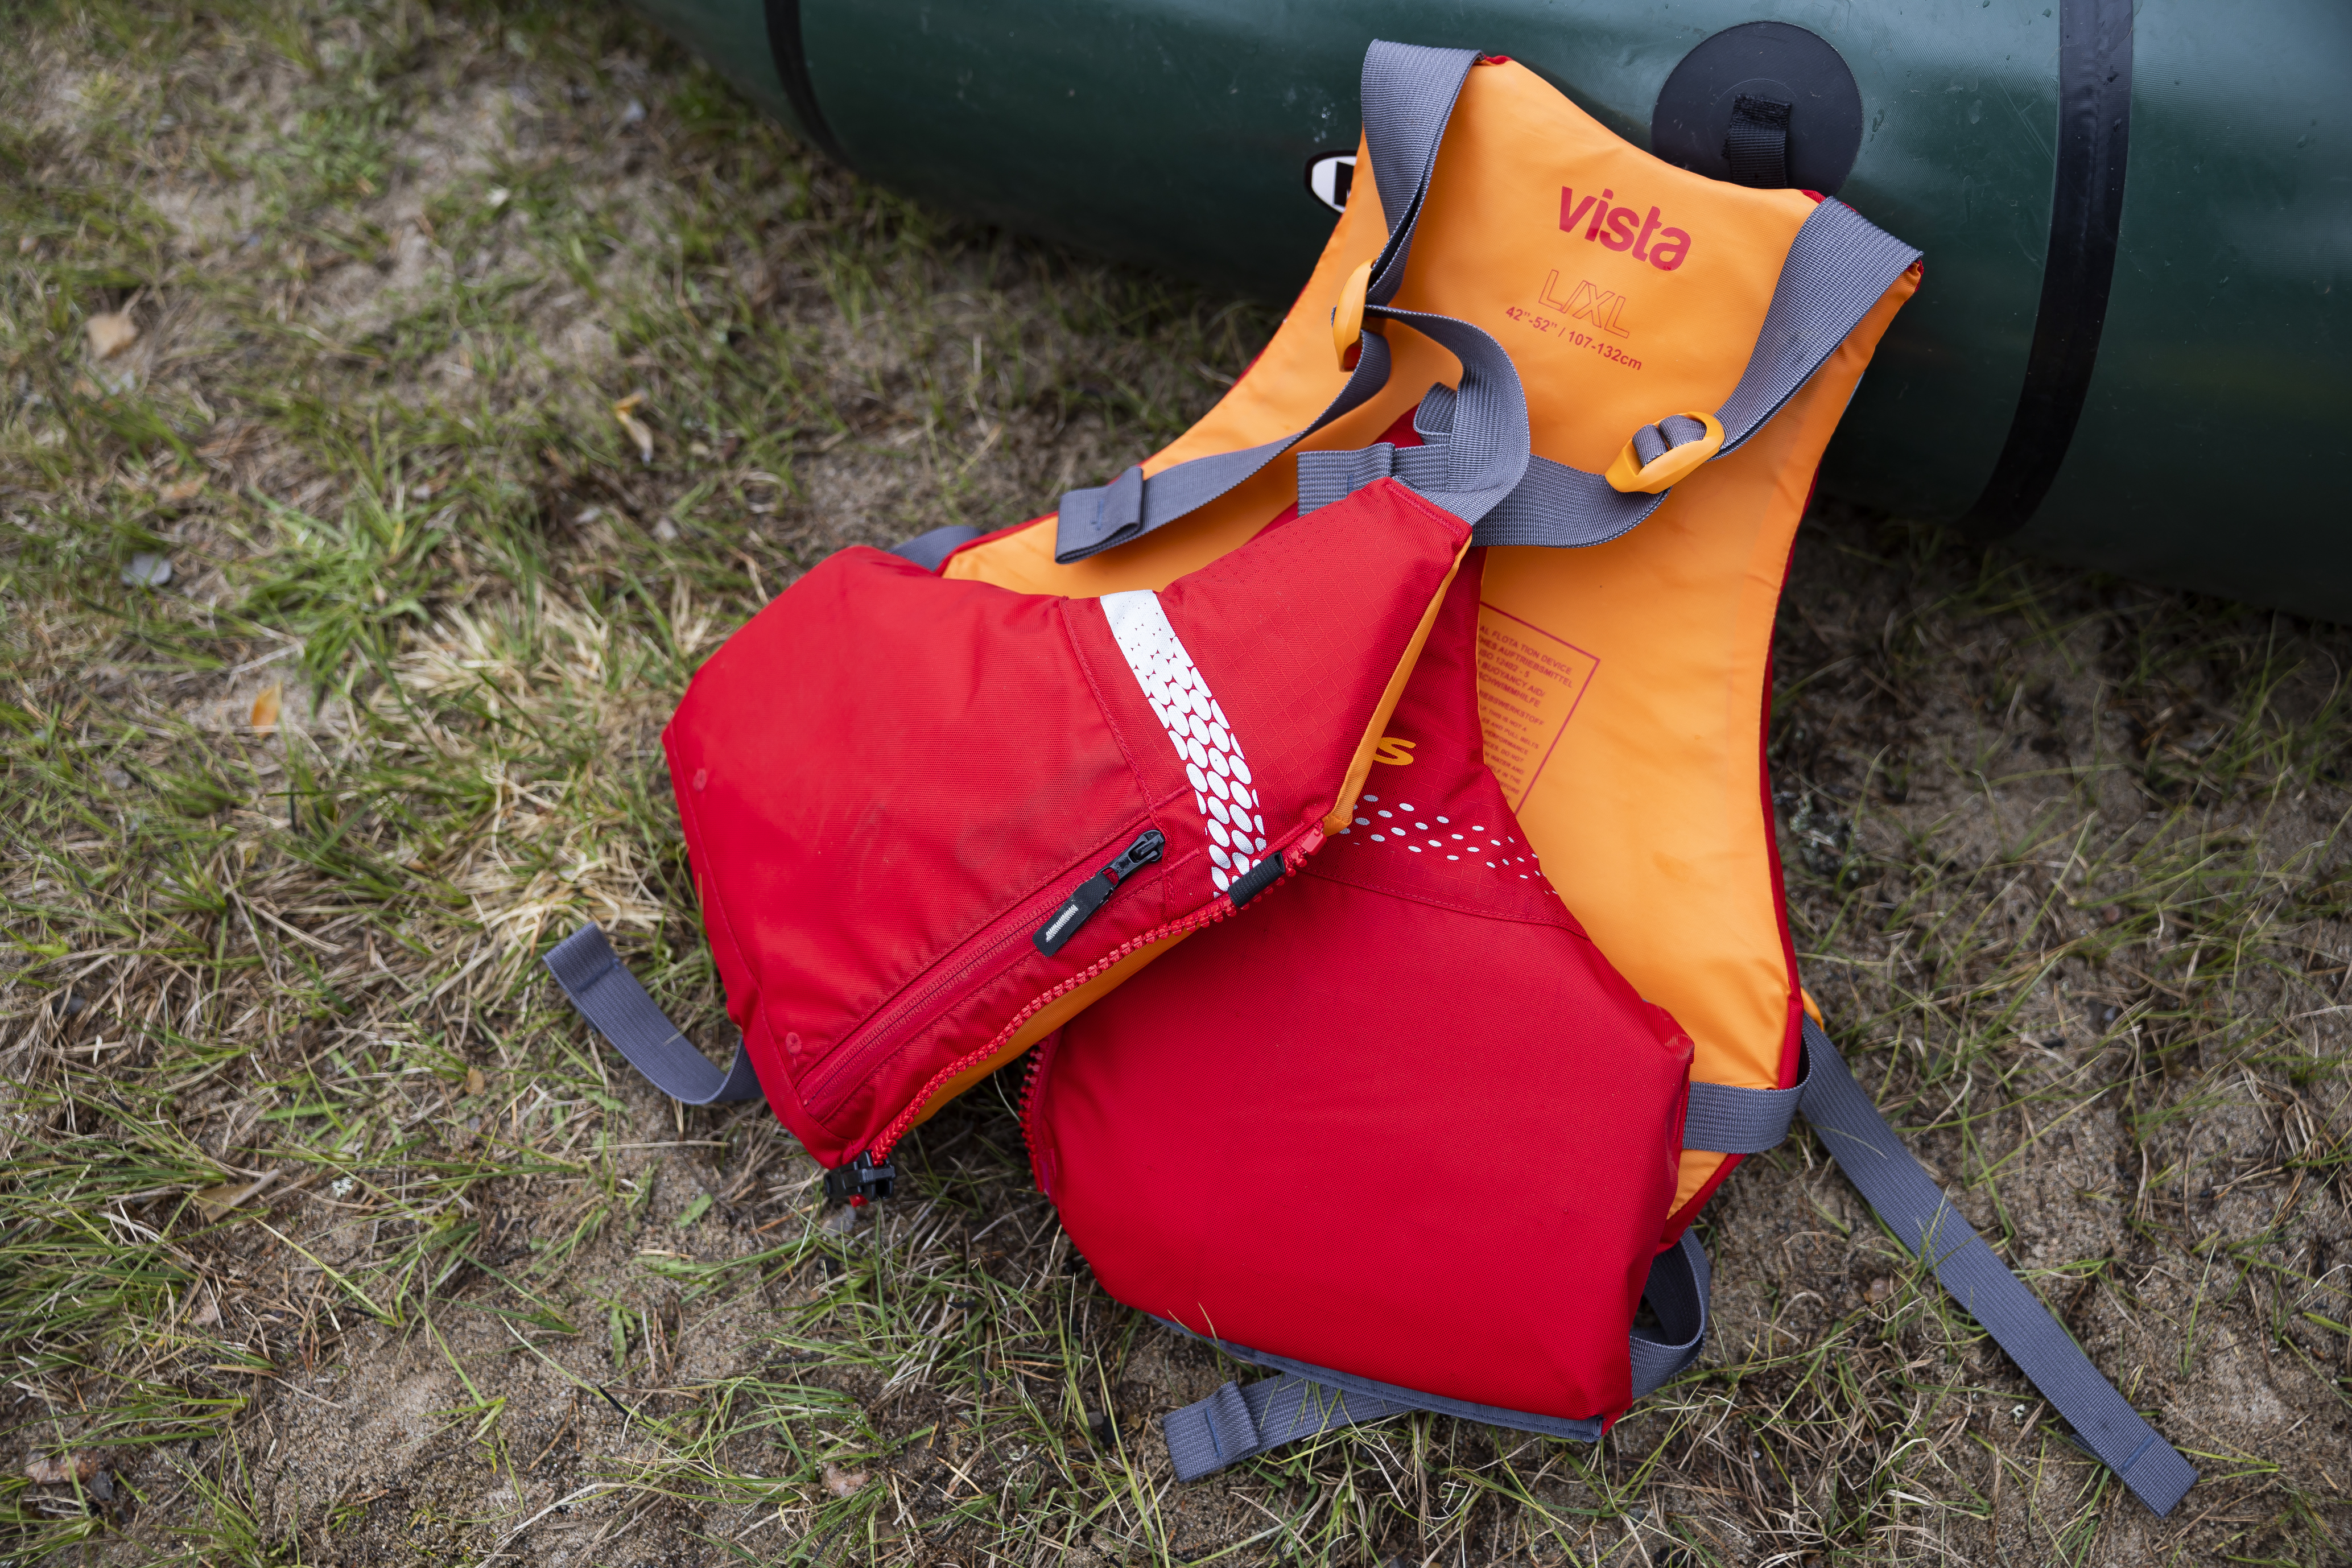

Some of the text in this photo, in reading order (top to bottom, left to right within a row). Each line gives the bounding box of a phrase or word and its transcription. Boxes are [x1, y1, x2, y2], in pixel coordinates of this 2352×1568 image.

[1559, 185, 1691, 271] vista
[1538, 269, 1629, 339] L/XL
[1568, 330, 1642, 371] 107-132cm
[1482, 662, 1528, 687] BUOYANCY
[1498, 647, 1573, 688] AUFTRIEBSMITTEL
[1541, 655, 1572, 675] DEVICE
[1484, 729, 1528, 754] PERFORMANCE
